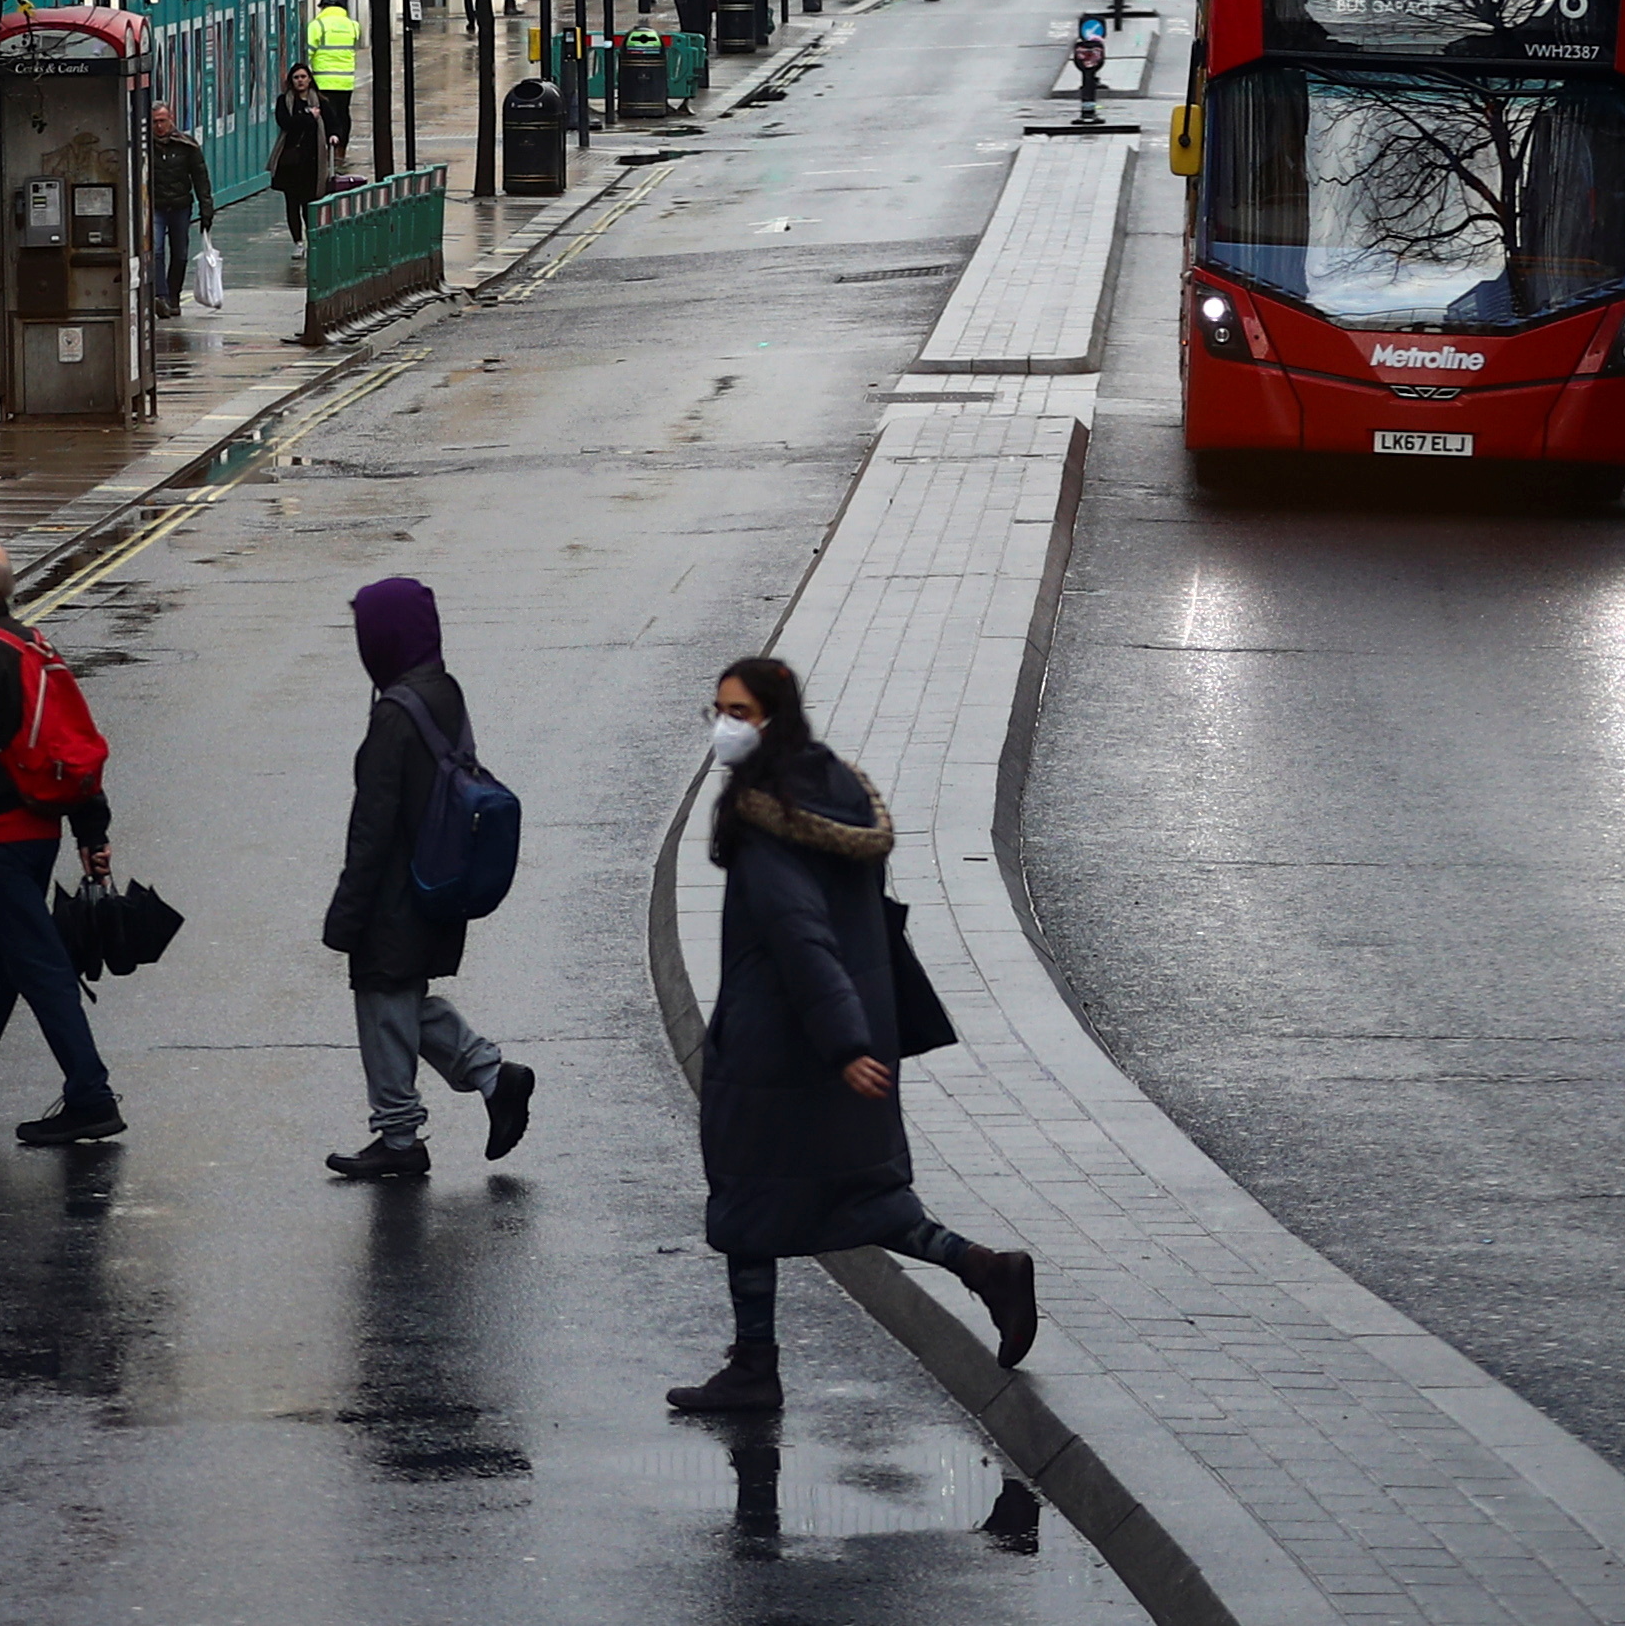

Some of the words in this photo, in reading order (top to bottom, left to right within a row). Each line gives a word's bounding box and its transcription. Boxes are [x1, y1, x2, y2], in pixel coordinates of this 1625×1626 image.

[1524, 43, 1600, 60] VWH2387
[1370, 343, 1484, 370] Metroline
[1381, 434, 1427, 451] LK67
[1431, 436, 1465, 453] ELJ
